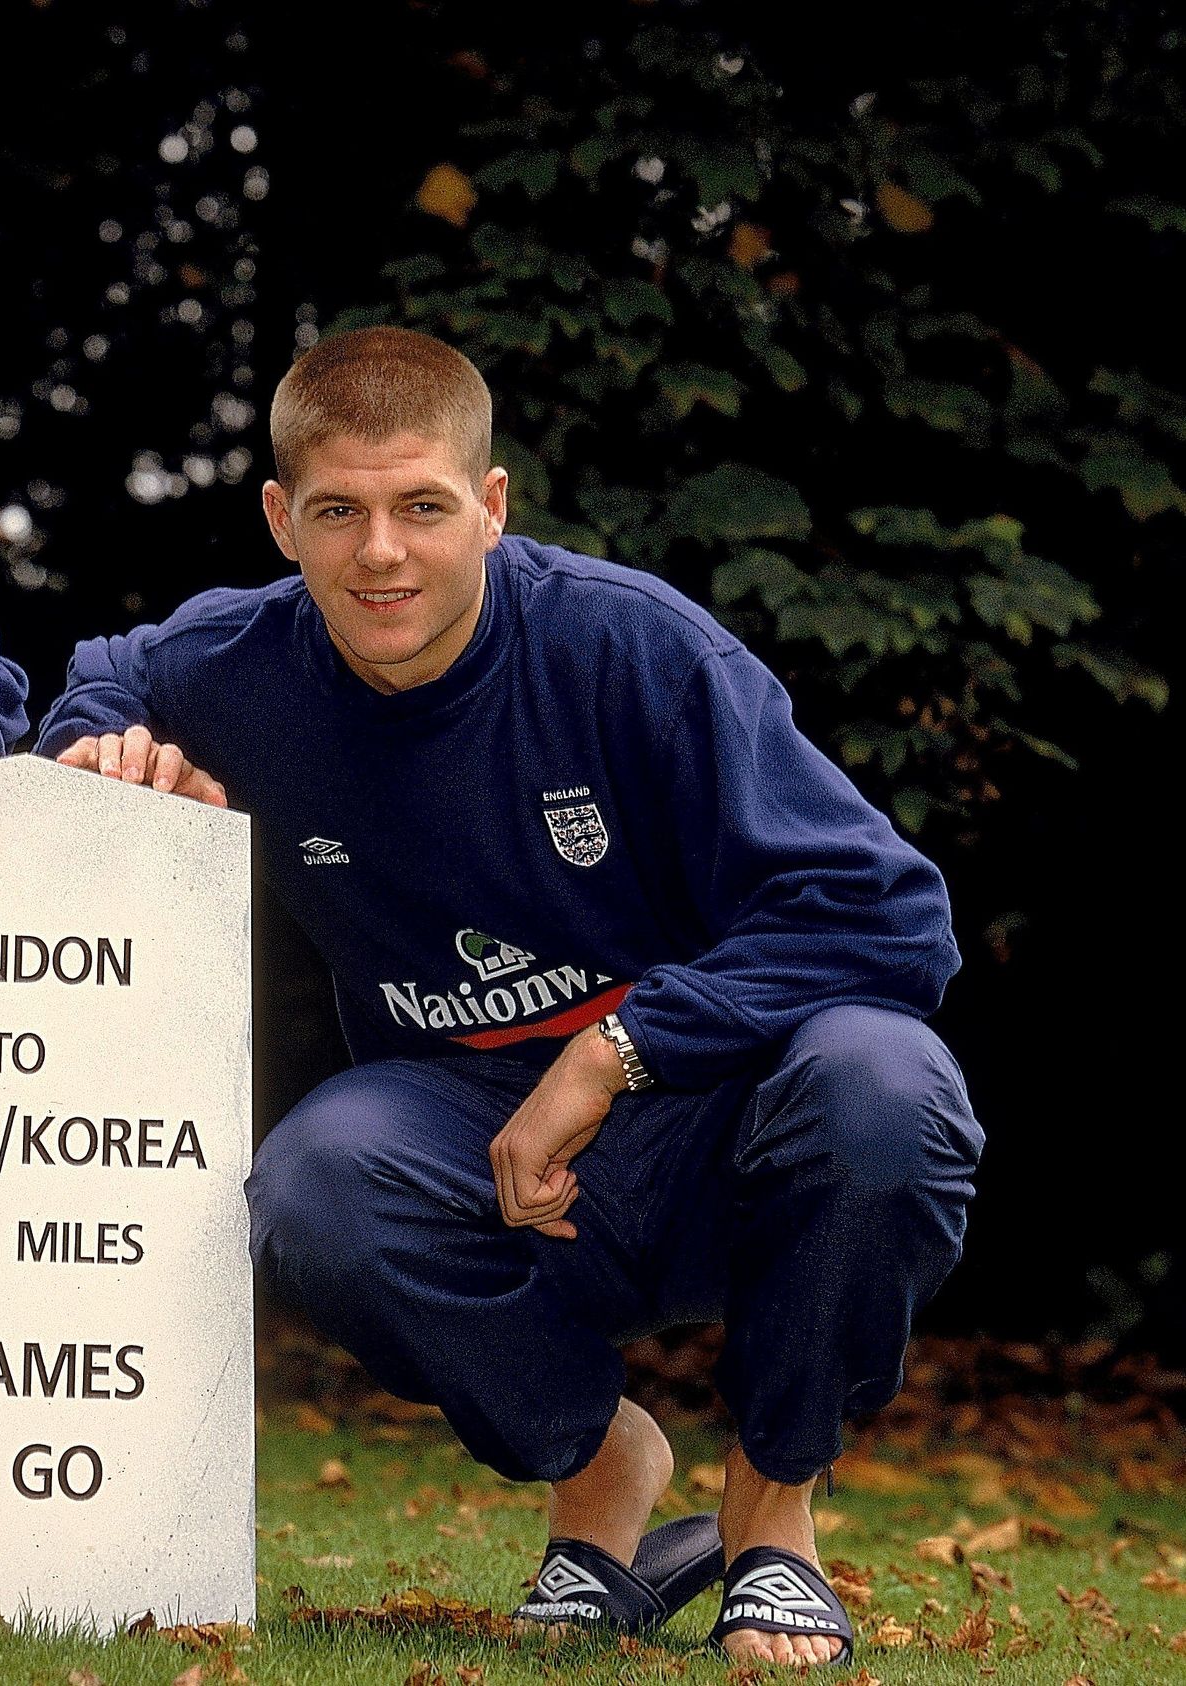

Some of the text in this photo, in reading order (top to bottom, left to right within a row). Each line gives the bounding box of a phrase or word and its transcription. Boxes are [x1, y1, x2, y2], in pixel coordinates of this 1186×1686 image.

[543, 785, 590, 801] ENGLAND
[303, 851, 350, 866] UMBRO
[379, 965, 613, 1030] Nationw
[17, 1220, 144, 1266] MILES
[12, 1443, 103, 1501] GO
[723, 1602, 840, 1630] UMBRO
